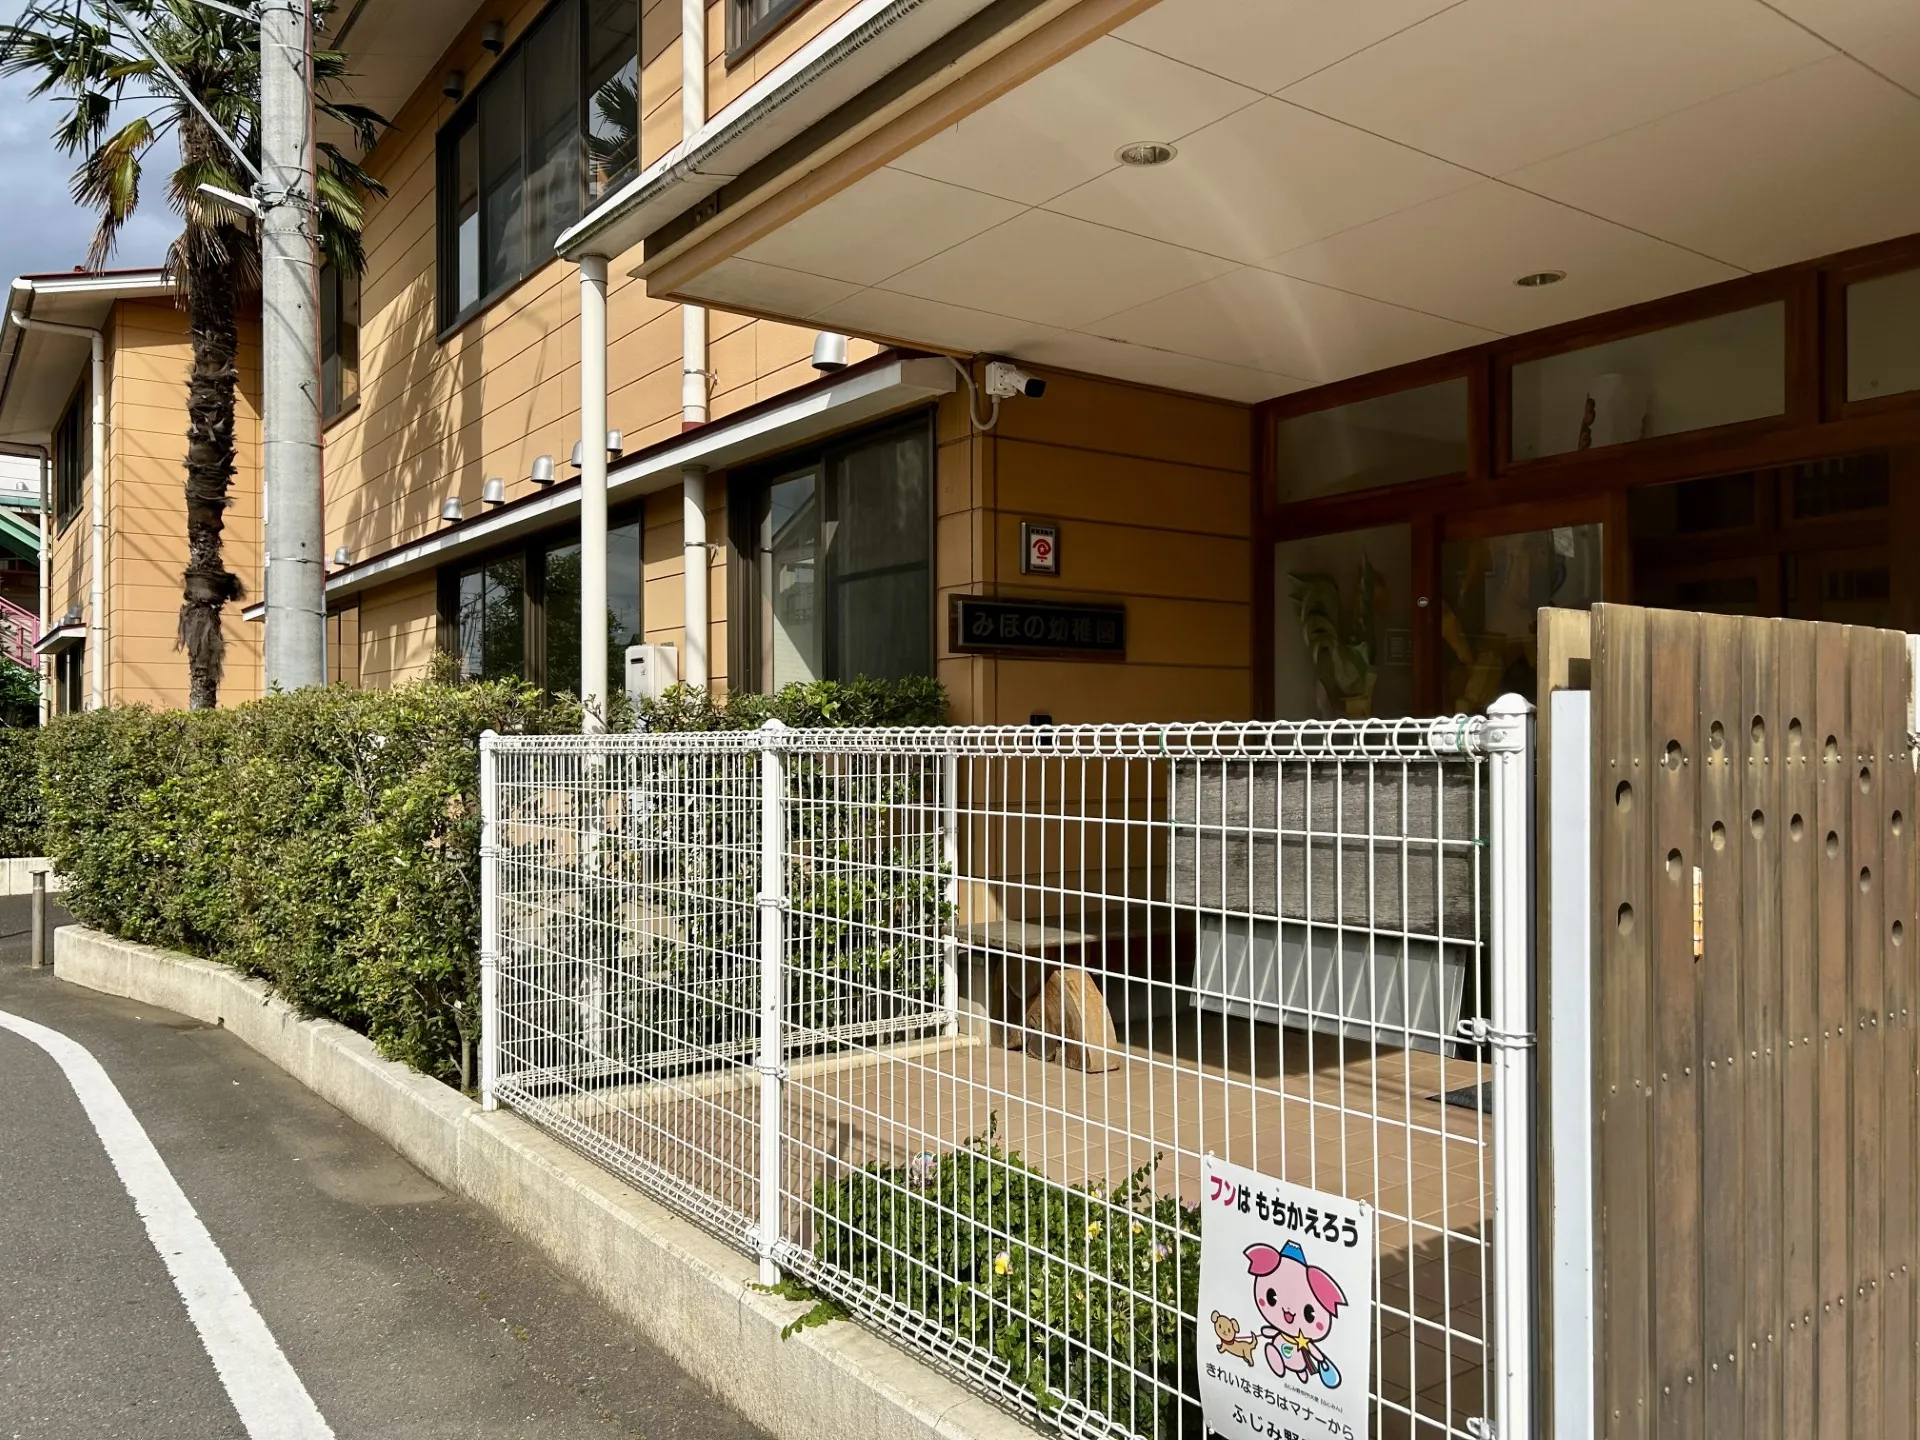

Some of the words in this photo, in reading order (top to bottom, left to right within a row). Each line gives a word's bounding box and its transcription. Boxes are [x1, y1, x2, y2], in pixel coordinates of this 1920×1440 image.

[972, 611, 1115, 644] みほの幼稚園
[1210, 1175, 1358, 1248] フンはもちかえろう
[1205, 1362, 1354, 1440] きれいなまちはマナーから
